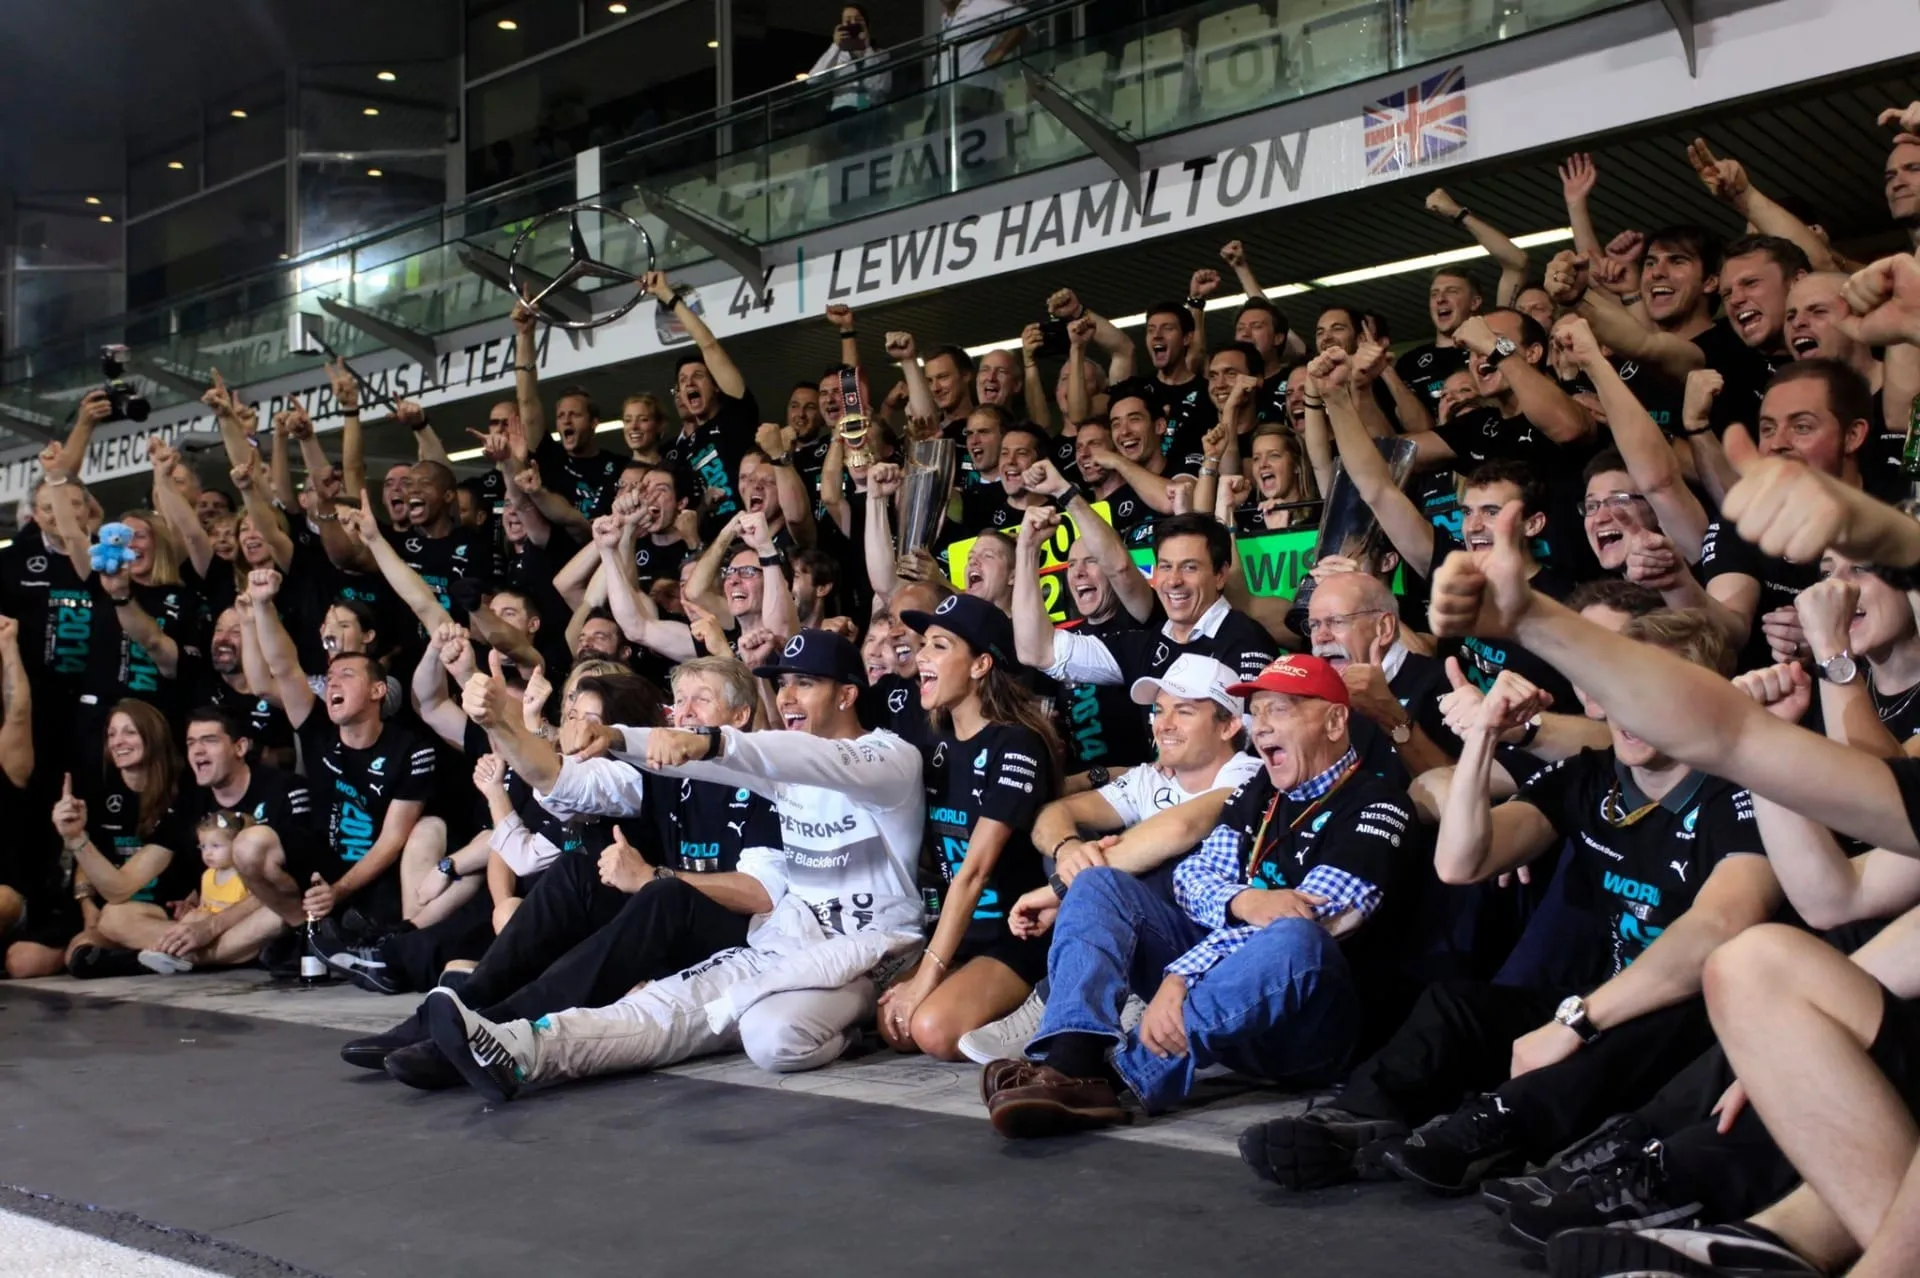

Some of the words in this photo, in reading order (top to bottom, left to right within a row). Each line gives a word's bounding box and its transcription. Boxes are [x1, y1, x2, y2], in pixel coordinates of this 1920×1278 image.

[828, 215, 981, 300] LEWIS
[994, 127, 1310, 262] HAMILTON
[268, 363, 410, 430] PETRNAS
[1004, 752, 1038, 767] PETRONAS
[997, 776, 1024, 790] Allianz
[929, 805, 968, 826] WORLD
[1364, 802, 1409, 821] TRONAS
[1355, 823, 1391, 840] Allianz
